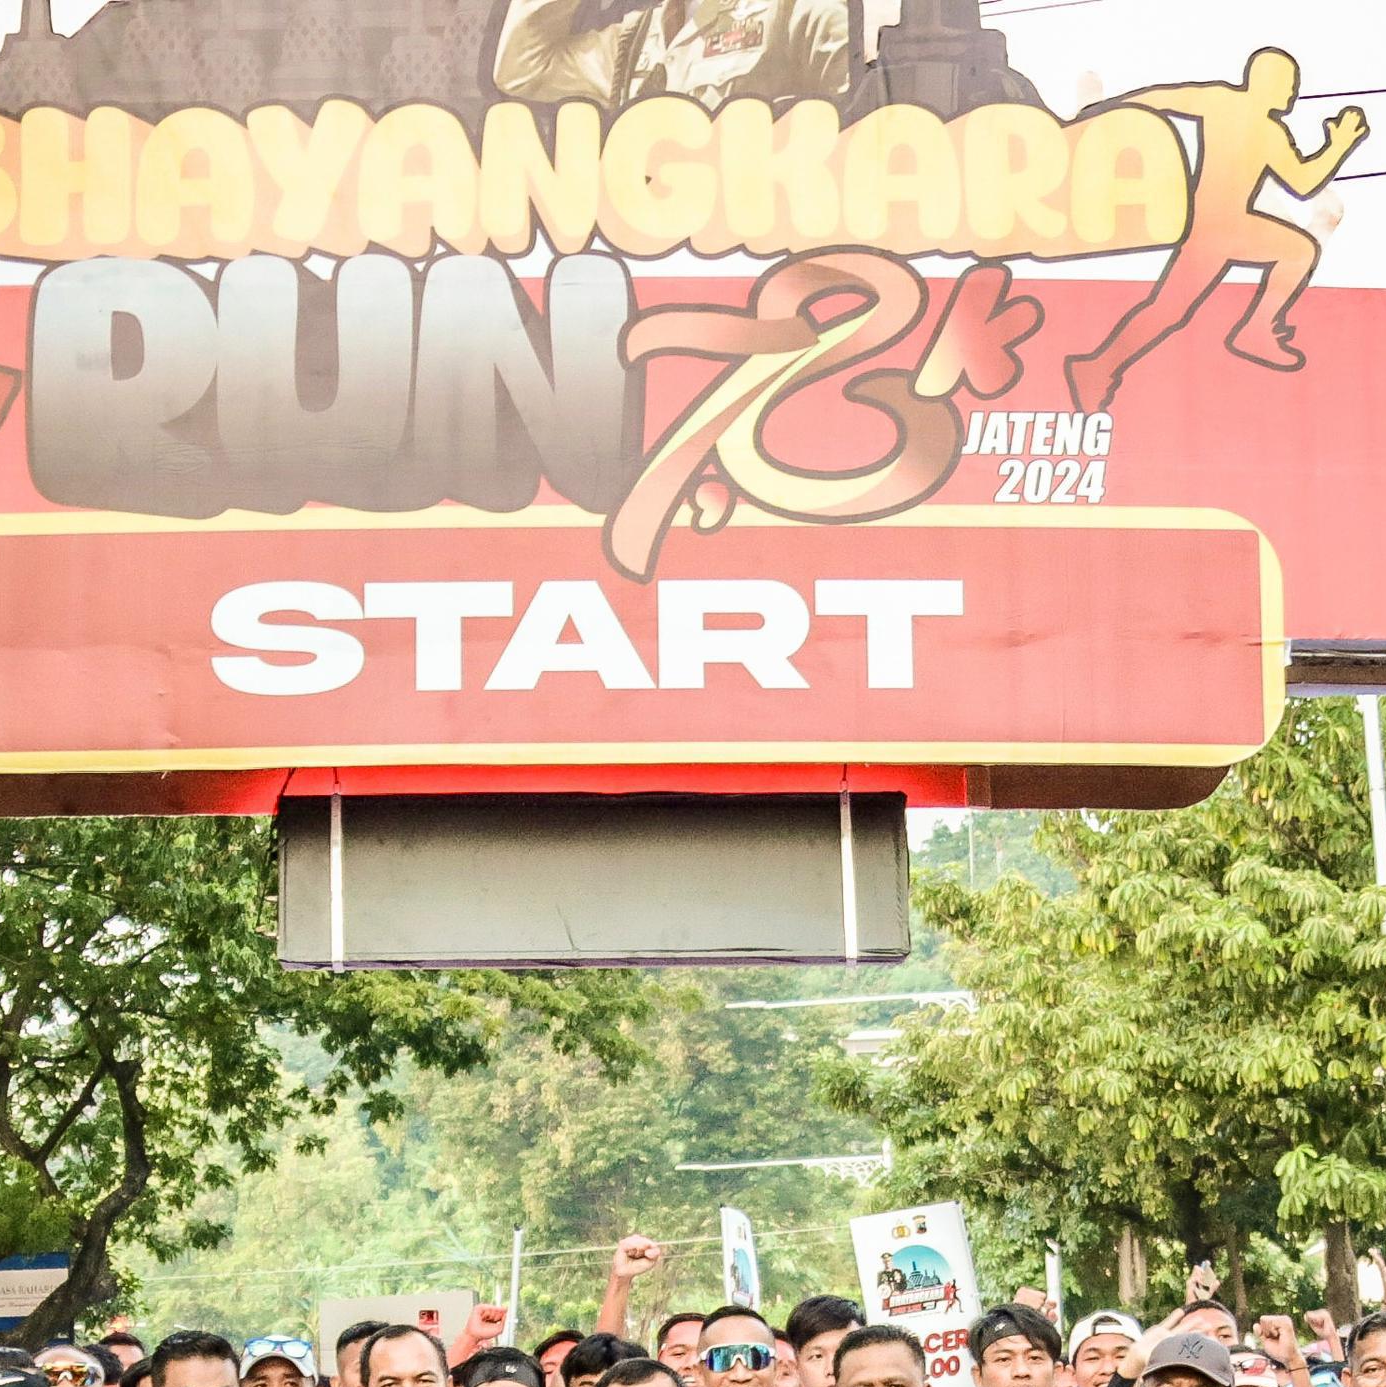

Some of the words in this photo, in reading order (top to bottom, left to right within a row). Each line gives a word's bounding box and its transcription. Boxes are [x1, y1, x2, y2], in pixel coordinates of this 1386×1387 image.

[32, 256, 632, 511] RUN
[963, 411, 1113, 455] JATENG
[993, 460, 1106, 503] 2024
[211, 579, 964, 697] START
